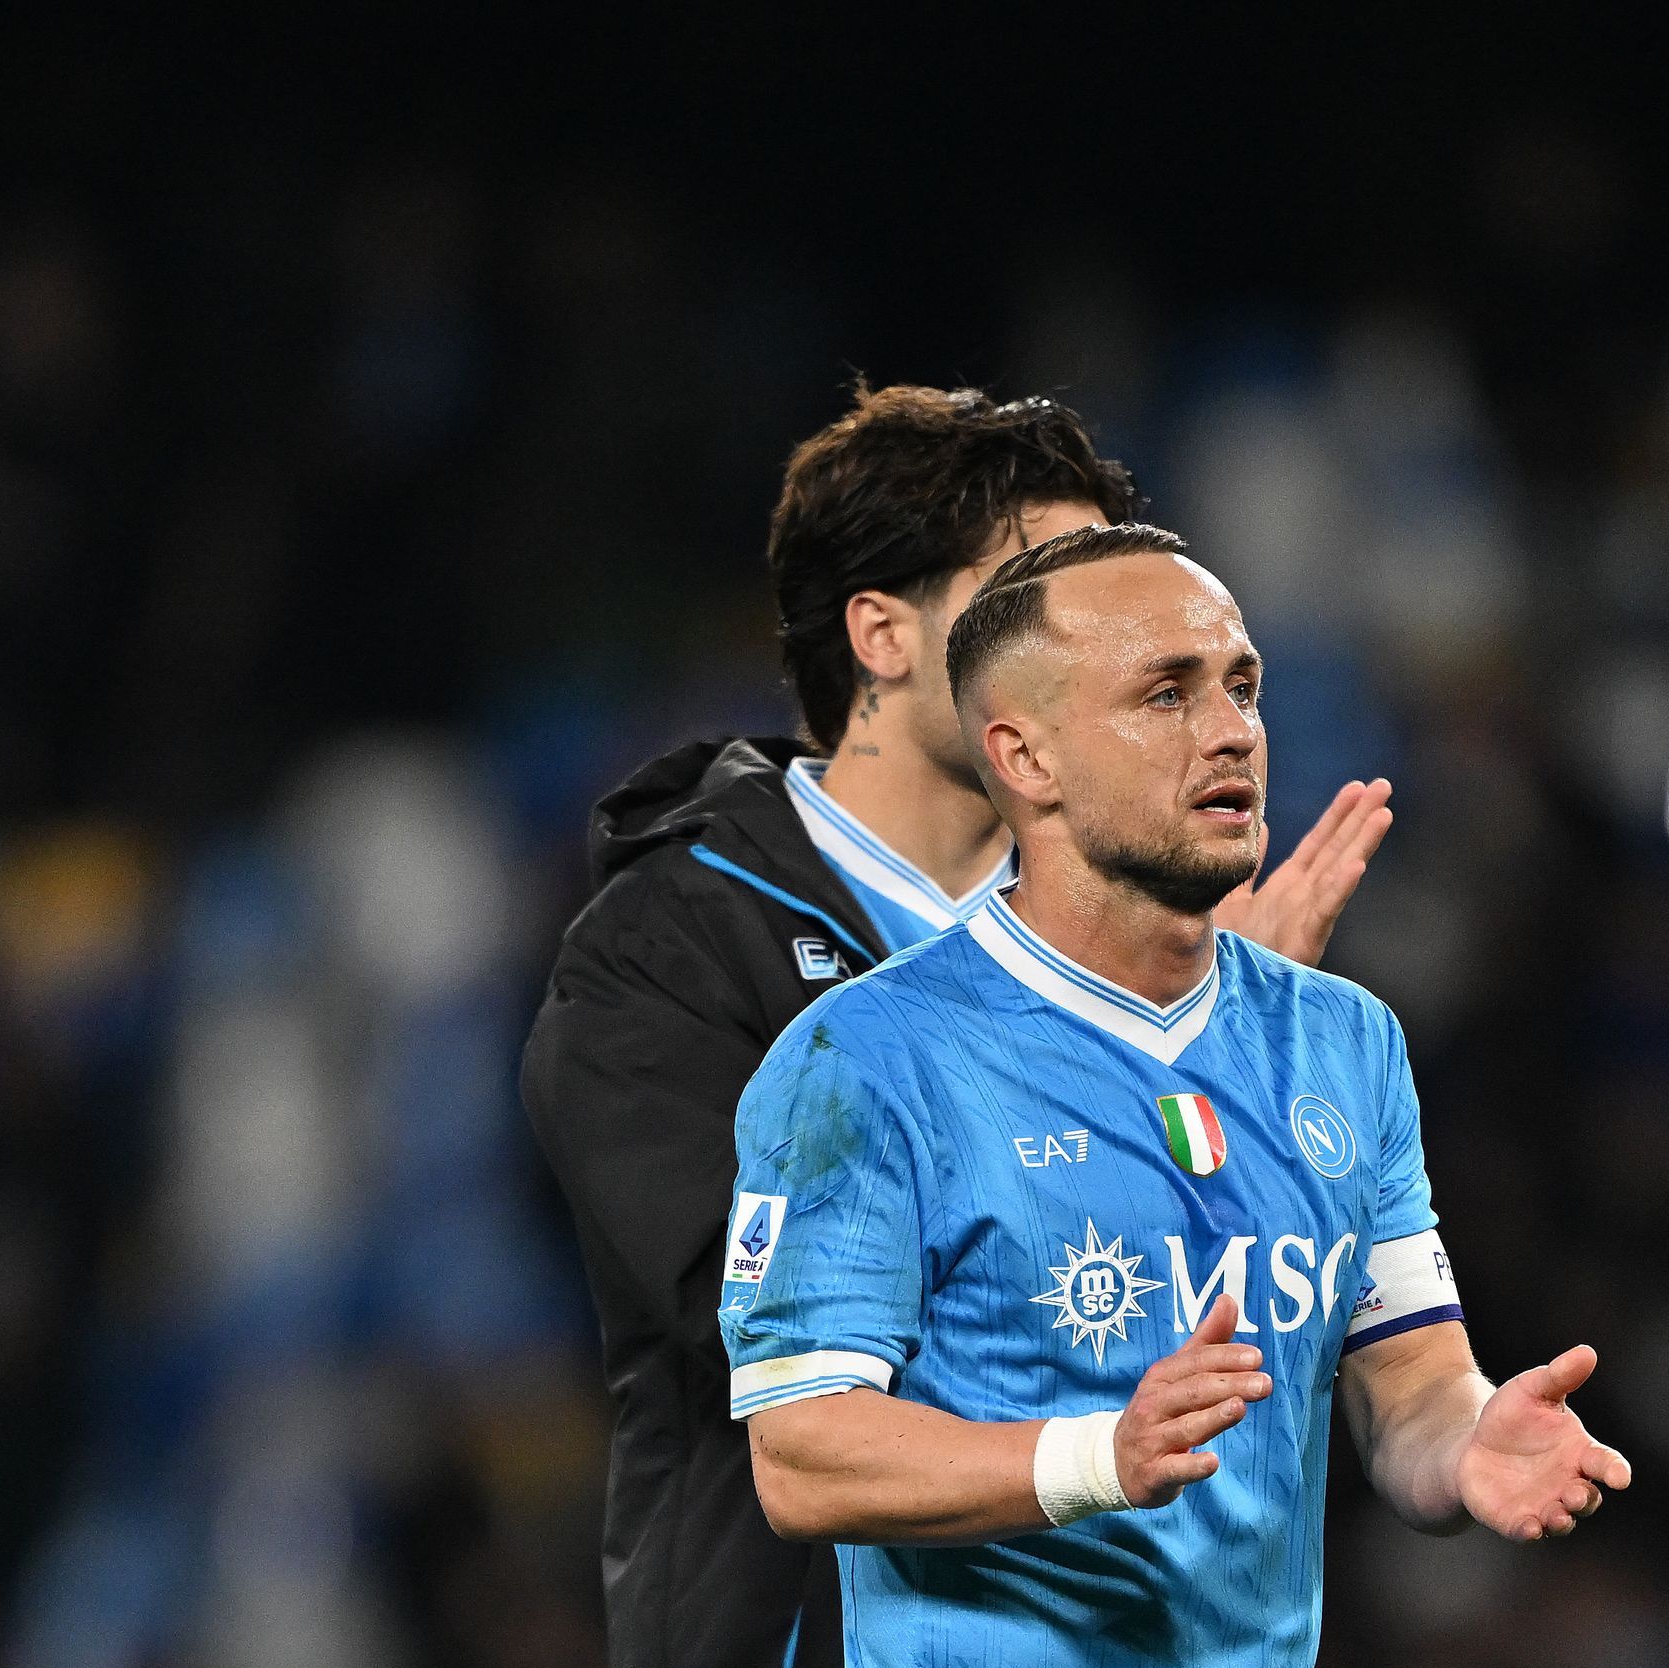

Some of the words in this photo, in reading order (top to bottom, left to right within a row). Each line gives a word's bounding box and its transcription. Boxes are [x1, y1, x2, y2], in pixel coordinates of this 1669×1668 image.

[1013, 1129, 1090, 1168] EA7
[733, 1259, 759, 1271] SERIE
[758, 1261, 765, 1272] A
[1352, 1299, 1373, 1314] ERIE
